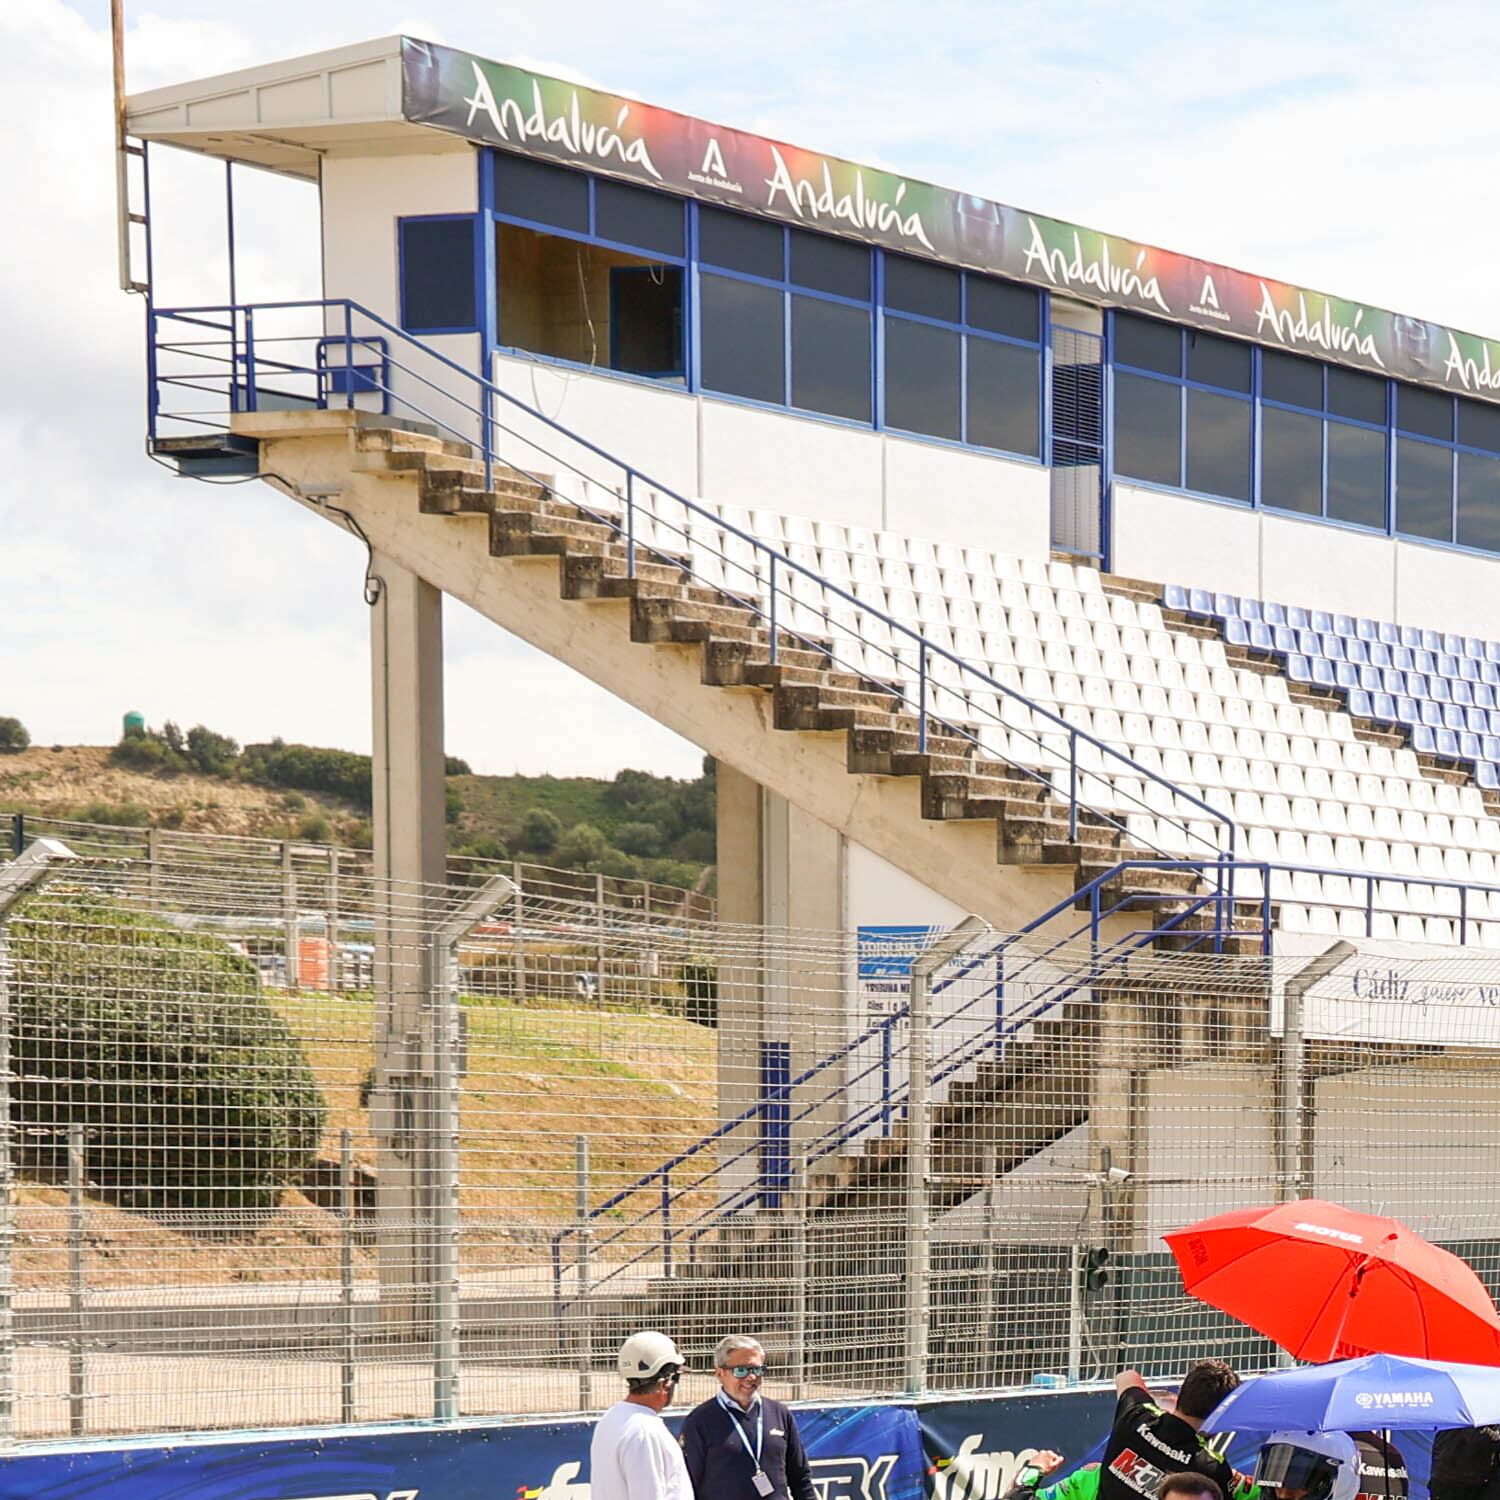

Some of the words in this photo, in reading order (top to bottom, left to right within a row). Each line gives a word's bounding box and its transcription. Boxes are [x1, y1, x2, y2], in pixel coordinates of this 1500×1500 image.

[464, 60, 662, 180] Andalucía
[764, 146, 937, 251] Andalucía
[1023, 218, 1170, 312] Andalucía
[1256, 281, 1384, 368] Andalucía
[1353, 968, 1409, 1001] Cádiz
[1373, 1391, 1434, 1405] YAMAHA
[1136, 1422, 1192, 1465] Kawasaki
[1358, 1462, 1409, 1479] Kawsak
